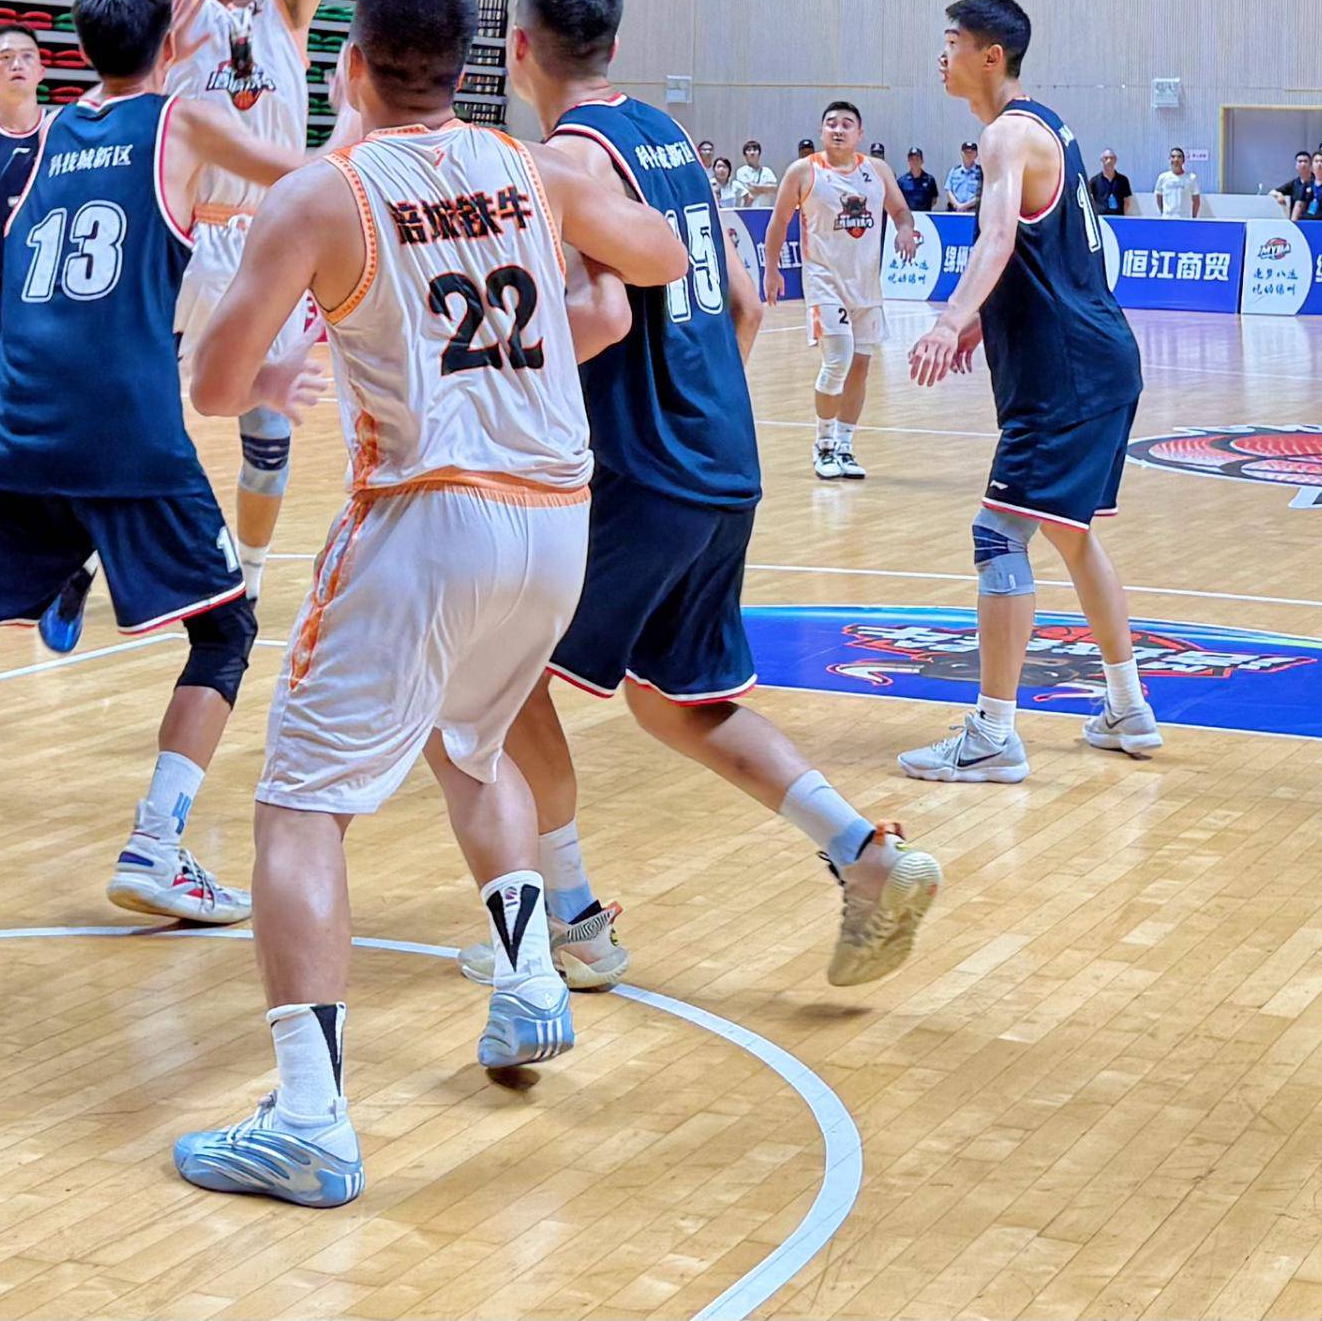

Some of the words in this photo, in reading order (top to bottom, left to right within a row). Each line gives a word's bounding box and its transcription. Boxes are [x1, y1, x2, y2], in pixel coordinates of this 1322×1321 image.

[862, 171, 872, 182] 2
[21, 199, 127, 303] 13
[1122, 248, 1231, 283] 恒江商贸
[427, 264, 545, 377] 22
[837, 306, 849, 326] 2
